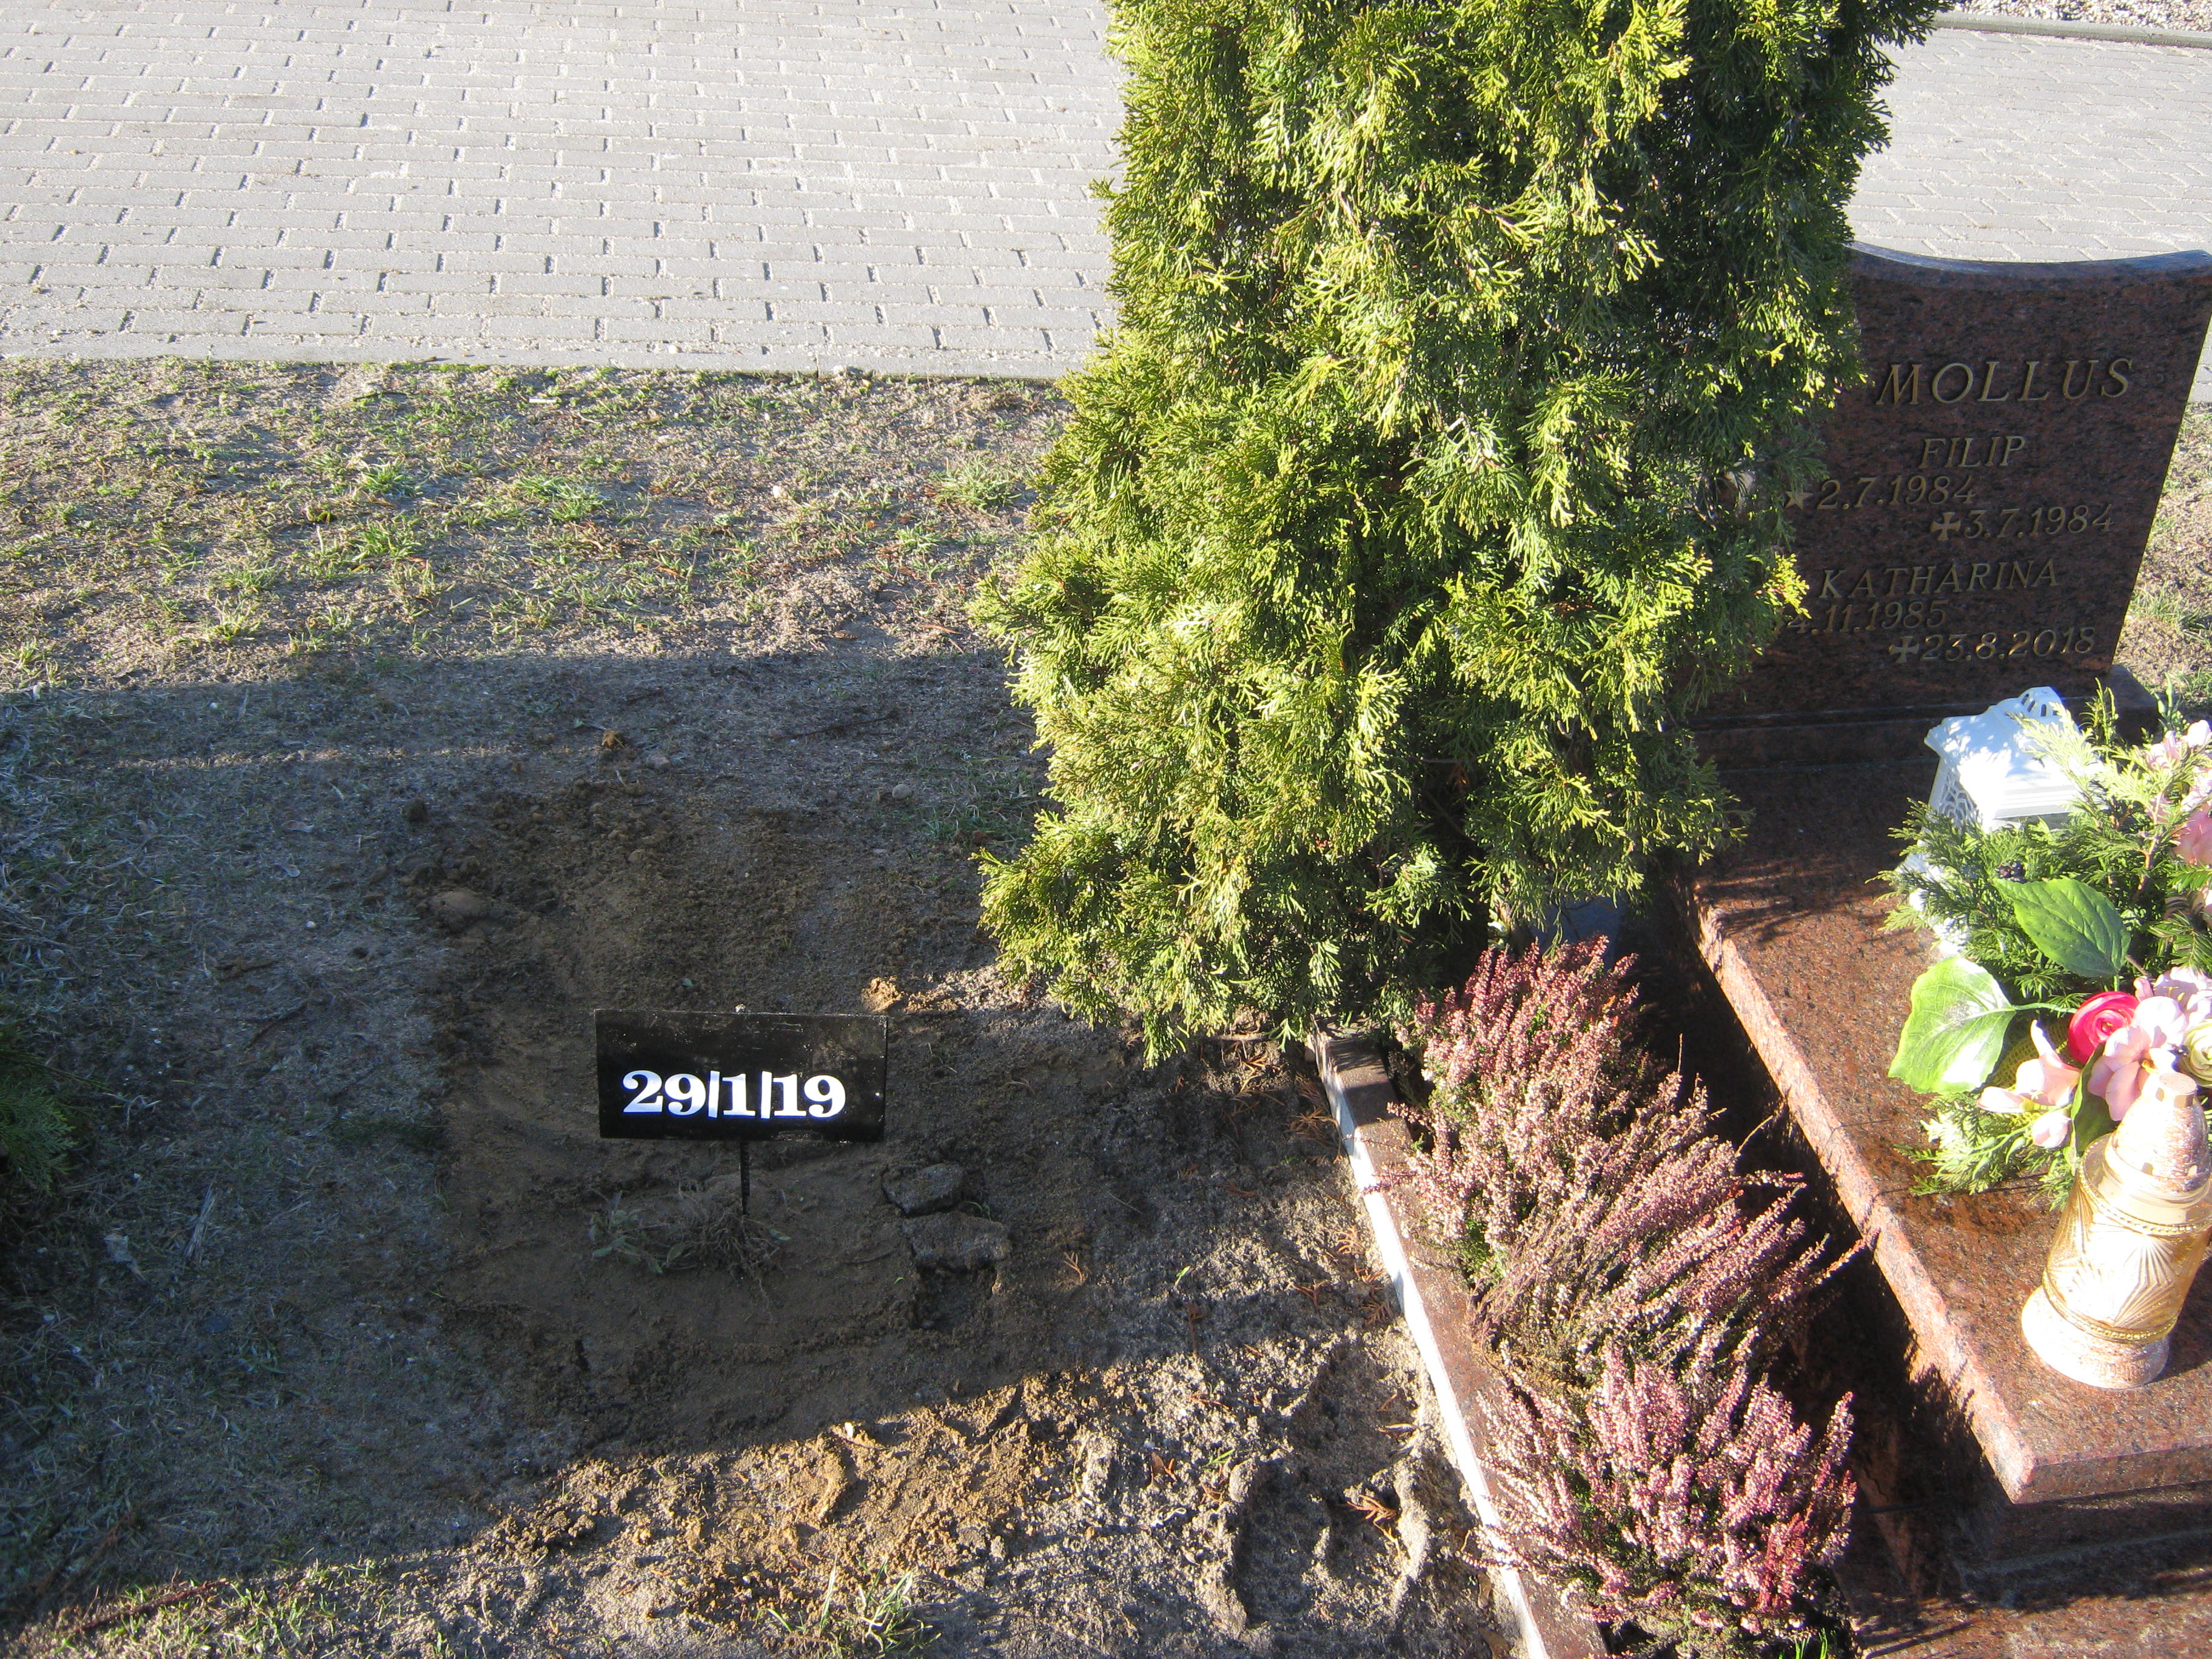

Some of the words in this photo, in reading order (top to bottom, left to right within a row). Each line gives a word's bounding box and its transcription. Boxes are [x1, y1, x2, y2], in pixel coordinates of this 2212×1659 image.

[1876, 358, 2134, 405] MOLLUS
[1919, 436, 2027, 469] FILIP
[1818, 475, 1978, 510] 2.7.1984
[1965, 503, 2114, 540] 3.7.1984
[1819, 559, 2060, 599] KATHARINA
[1920, 627, 2096, 663] 23.8.2018
